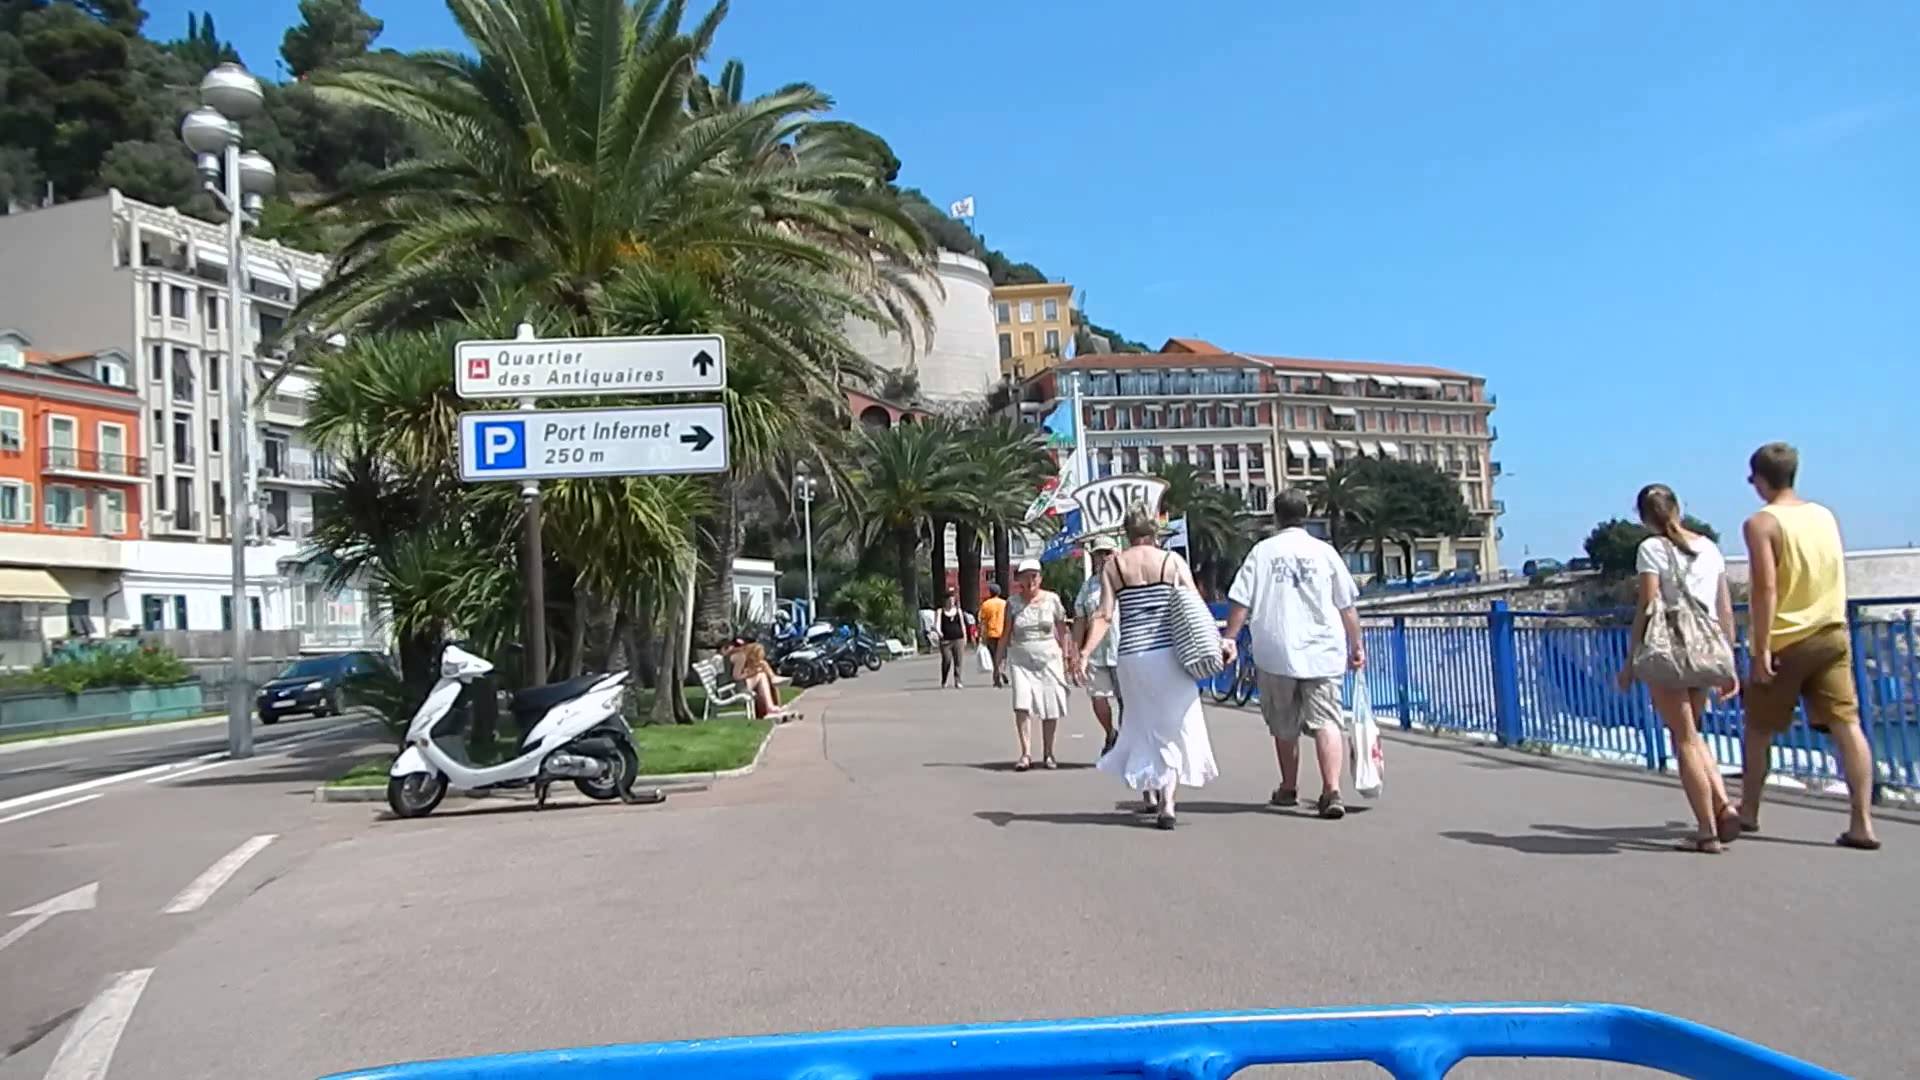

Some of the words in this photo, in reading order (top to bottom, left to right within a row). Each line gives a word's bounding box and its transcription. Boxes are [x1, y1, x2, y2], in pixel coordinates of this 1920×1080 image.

[497, 350, 583, 366] Quartier
[497, 372, 531, 387] des
[546, 368, 665, 387] Antiquaires
[543, 423, 585, 442] Port
[592, 421, 670, 439] Infernet
[484, 426, 517, 465] P
[544, 448, 584, 464] 250
[588, 450, 605, 463] m
